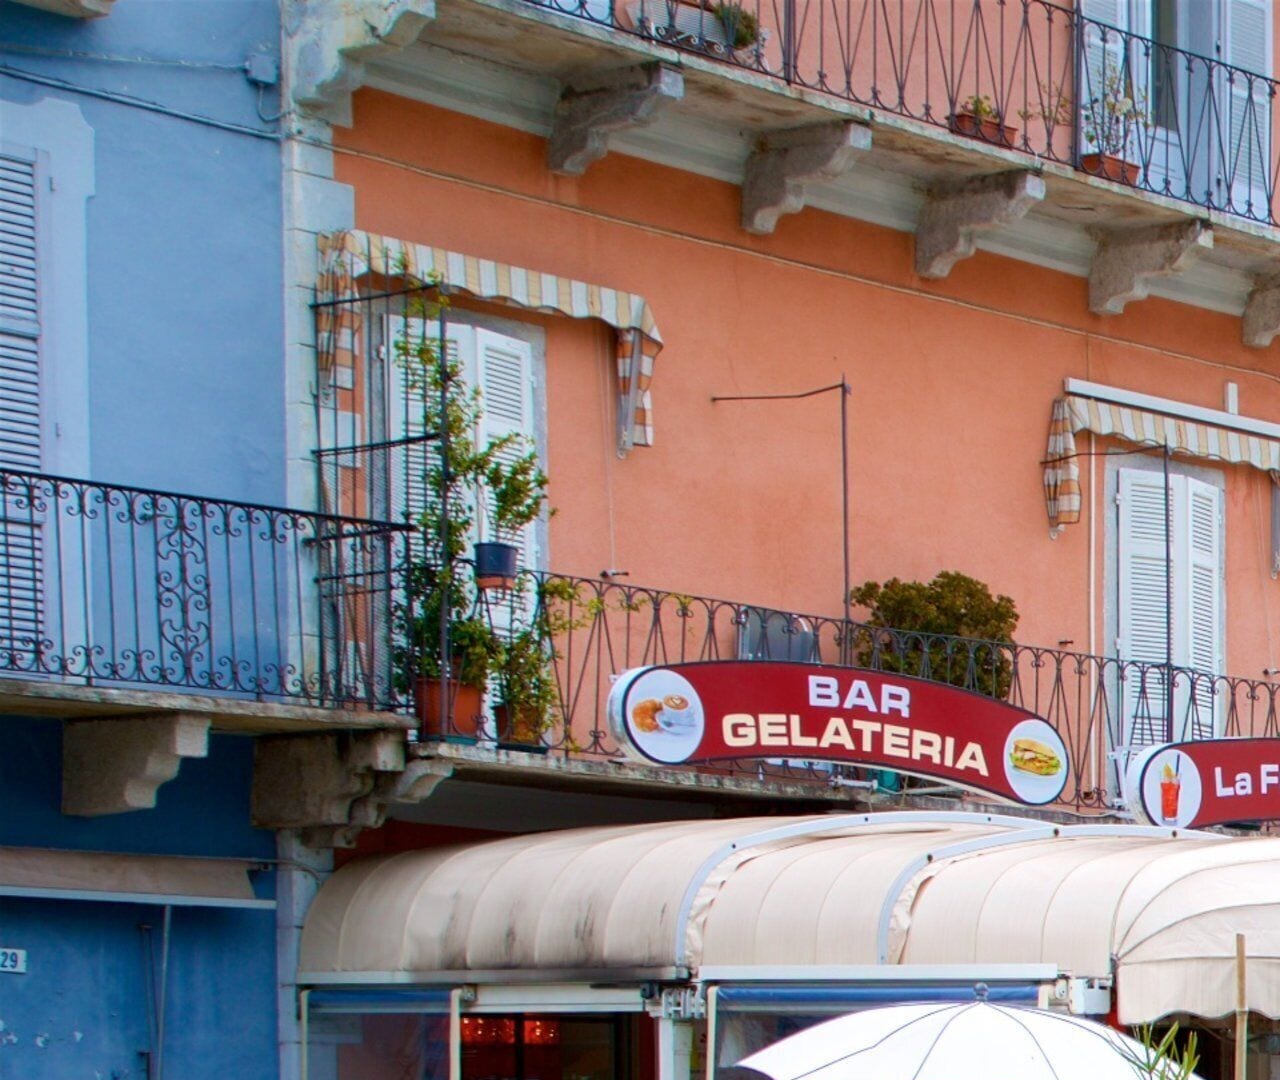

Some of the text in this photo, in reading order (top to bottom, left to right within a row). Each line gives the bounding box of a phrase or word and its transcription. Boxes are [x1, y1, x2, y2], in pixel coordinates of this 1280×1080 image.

[808, 675, 910, 718] BAR
[722, 713, 990, 777] GELATERIA
[1214, 766, 1252, 797] La
